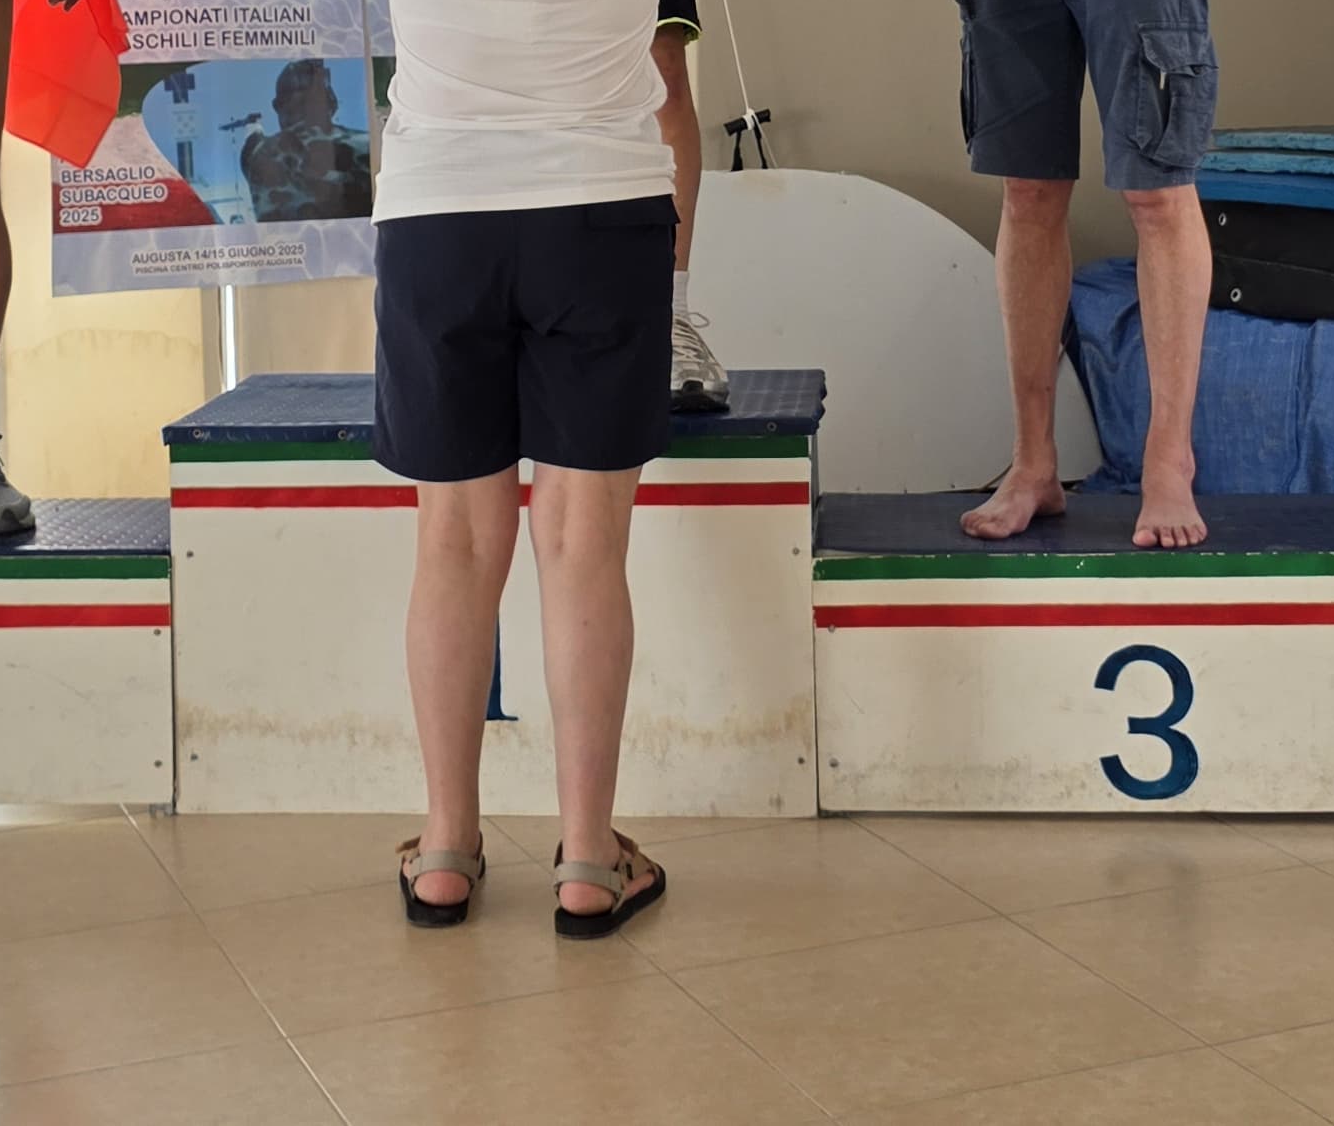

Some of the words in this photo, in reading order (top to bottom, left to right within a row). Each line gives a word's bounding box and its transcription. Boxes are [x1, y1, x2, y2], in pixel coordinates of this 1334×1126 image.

[123, 8, 229, 26] AMPIONATI
[234, 7, 311, 23] ITALIANI
[124, 32, 197, 50] SCHILI
[204, 30, 216, 46] E
[222, 29, 315, 47] FEMMINILI
[62, 166, 155, 184] BERSAGLIO
[62, 185, 165, 203] SUBACQUEO
[62, 209, 100, 223] 2025
[132, 251, 191, 265] AUGUSTA
[195, 248, 225, 261] 14/15
[228, 246, 276, 260] GIUGNO
[278, 244, 304, 256] 2025
[169, 263, 204, 273] CENTRO
[266, 257, 303, 267] AUGUSTA
[1094, 644, 1199, 800] 3
